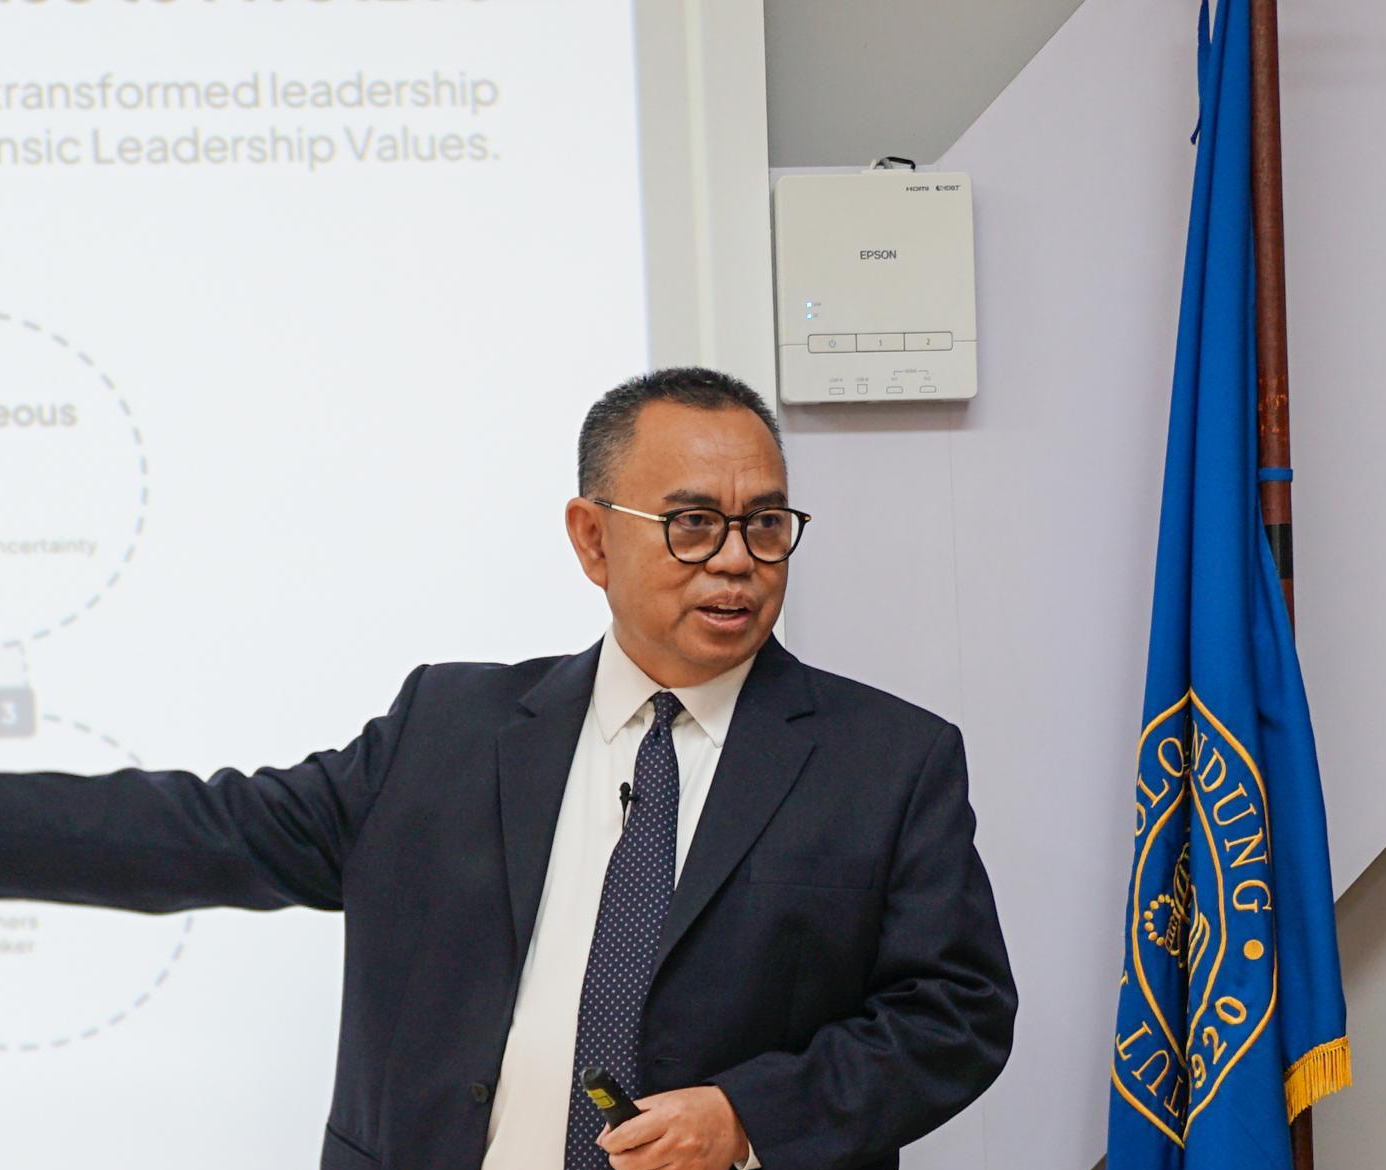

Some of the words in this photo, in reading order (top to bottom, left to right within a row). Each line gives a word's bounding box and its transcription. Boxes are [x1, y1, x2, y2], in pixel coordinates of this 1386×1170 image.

[270, 69, 499, 116] leadership
[91, 125, 337, 173] Leadership
[343, 124, 500, 165] Values.
[860, 250, 897, 260] EPSON
[1, 701, 18, 725] 3
